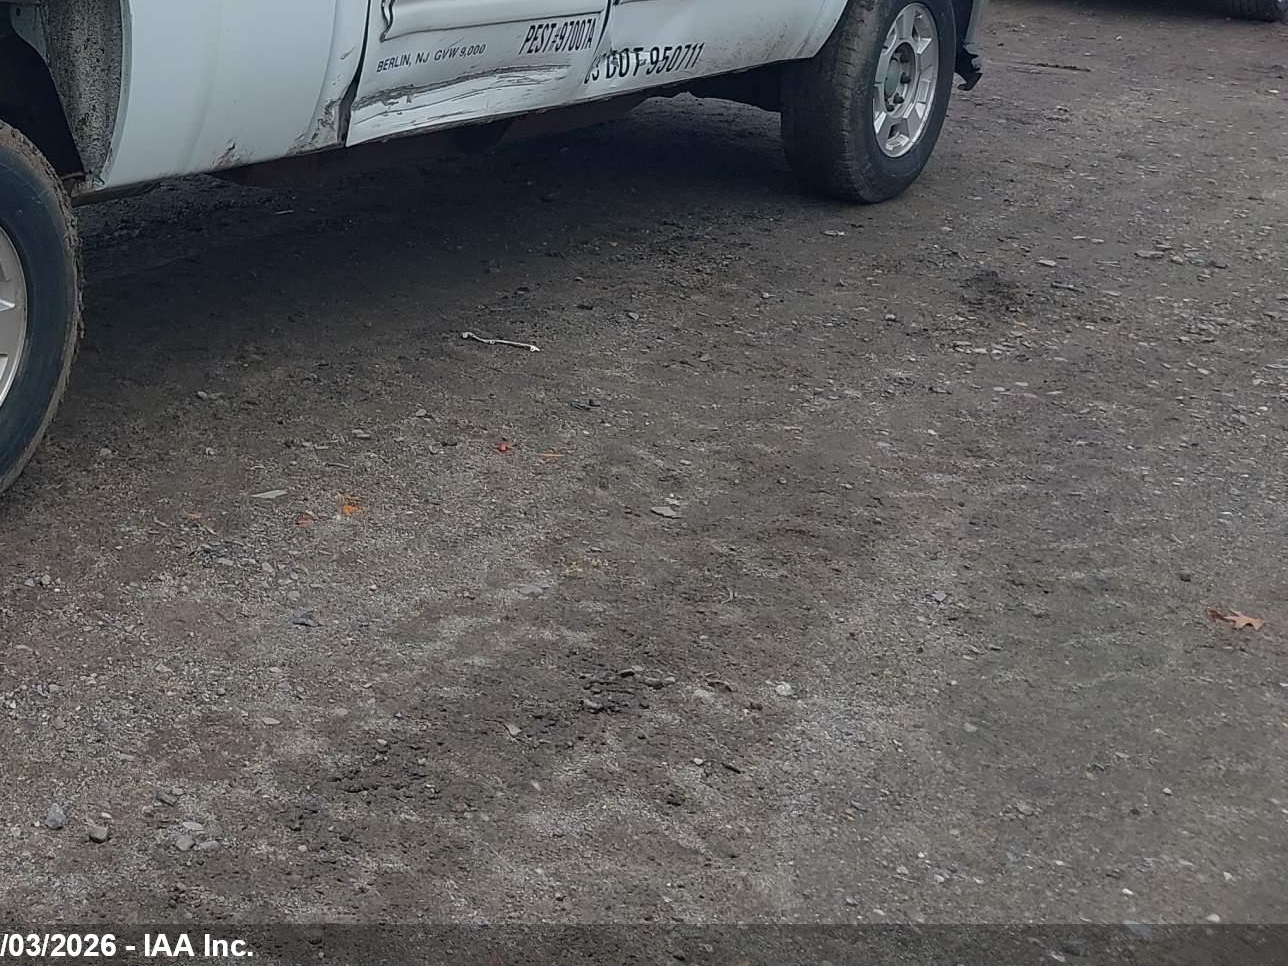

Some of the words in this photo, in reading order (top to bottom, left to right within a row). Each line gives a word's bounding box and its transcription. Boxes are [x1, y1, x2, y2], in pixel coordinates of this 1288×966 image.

[518, 17, 597, 56] PEST#97007A
[376, 53, 412, 73] BERLIN,
[415, 51, 430, 65] NJ
[433, 45, 460, 62] GVW
[459, 43, 487, 59] 9,000
